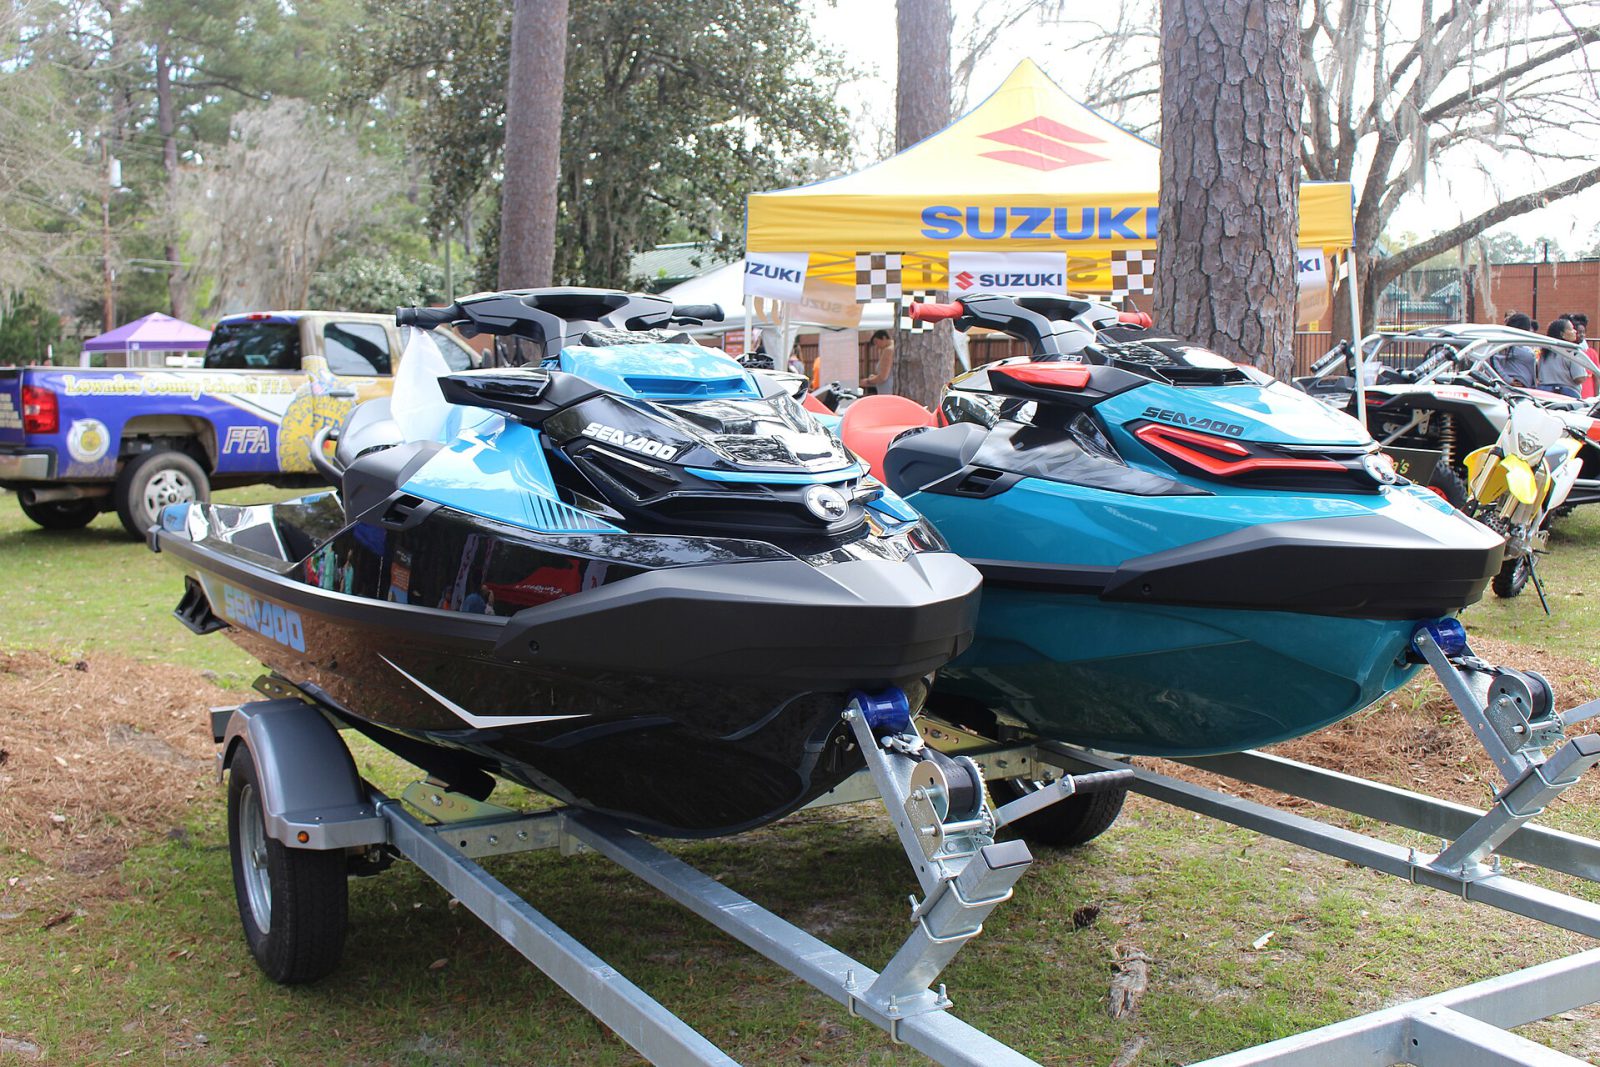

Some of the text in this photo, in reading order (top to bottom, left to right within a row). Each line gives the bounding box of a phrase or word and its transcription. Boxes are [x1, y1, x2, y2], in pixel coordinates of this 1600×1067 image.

[920, 205, 1159, 240] SUZUKI
[979, 273, 1062, 288] SUZUKI
[66, 375, 141, 394] Lowndes
[261, 379, 294, 394] FFA
[222, 426, 270, 454] FFA
